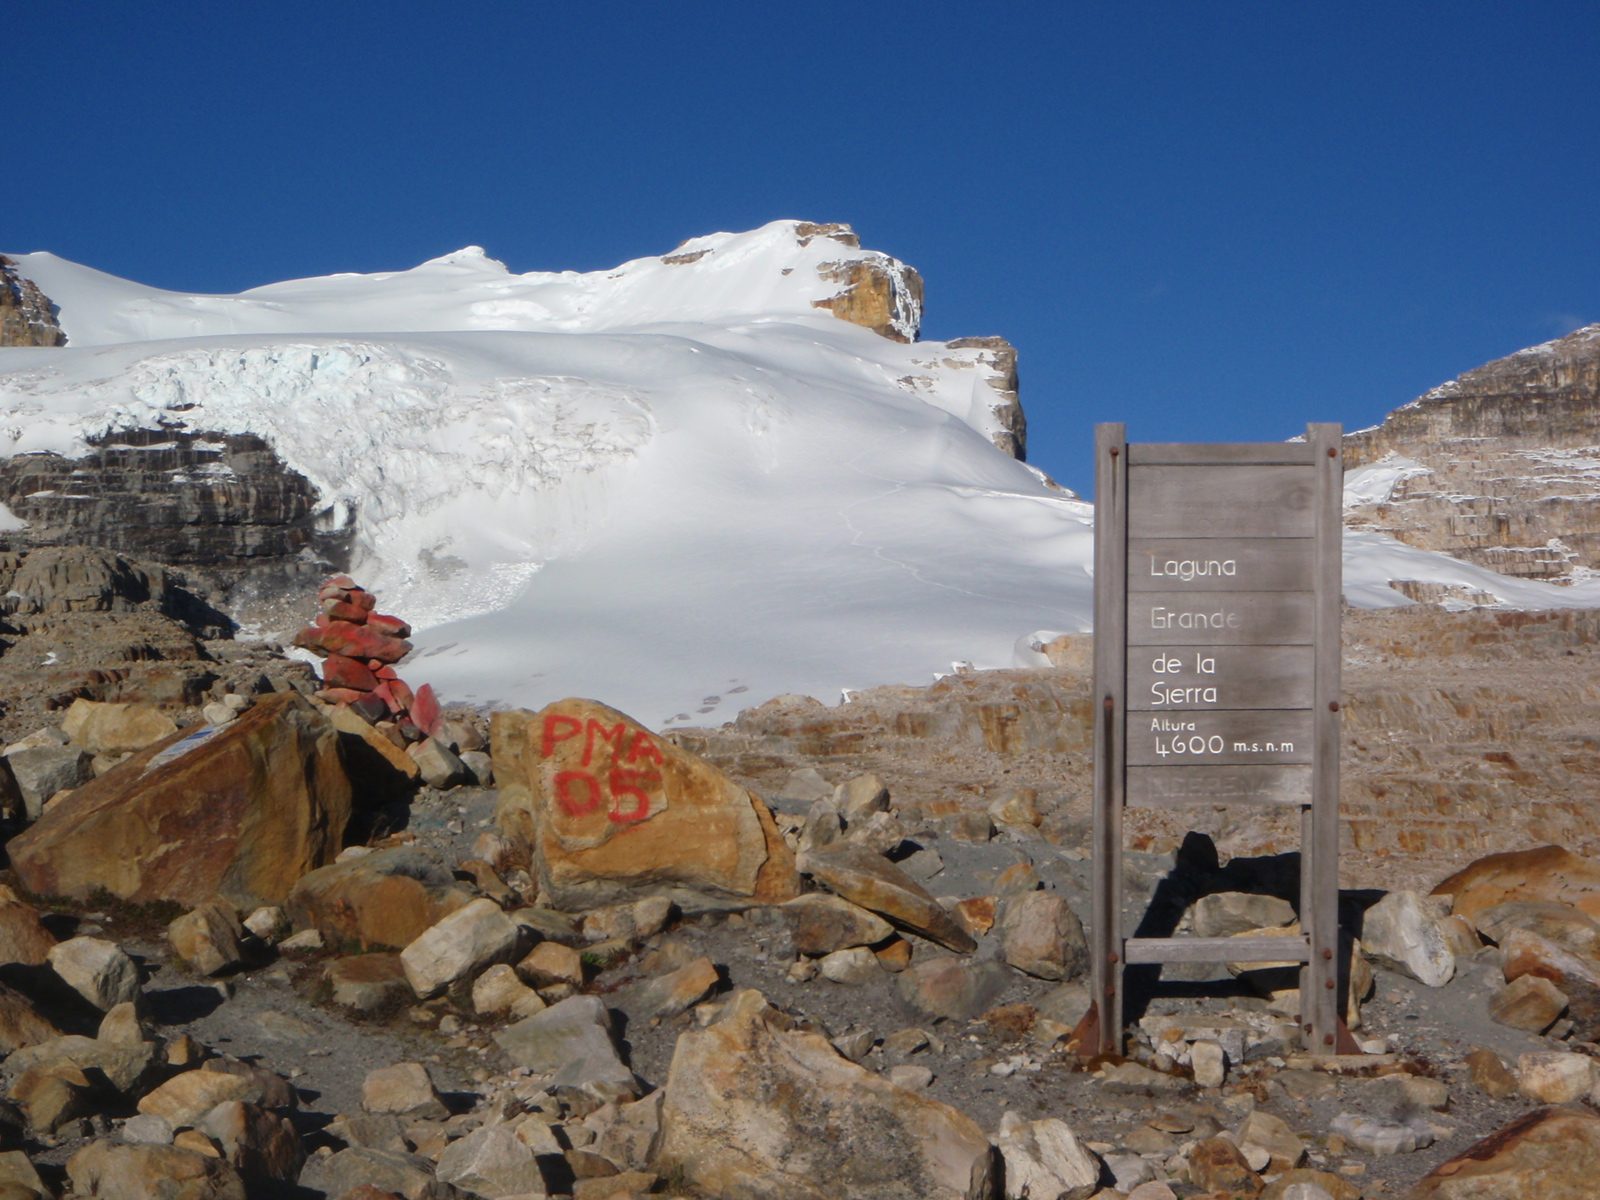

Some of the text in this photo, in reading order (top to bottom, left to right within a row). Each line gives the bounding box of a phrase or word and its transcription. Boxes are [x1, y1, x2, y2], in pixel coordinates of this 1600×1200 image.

[1151, 555, 1236, 582] Laguna
[1151, 607, 1241, 629] Grande
[1152, 652, 1215, 674] de la
[1151, 681, 1217, 705] Sierra
[1150, 718, 1196, 732] Altura
[1155, 735, 1224, 758] 4600
